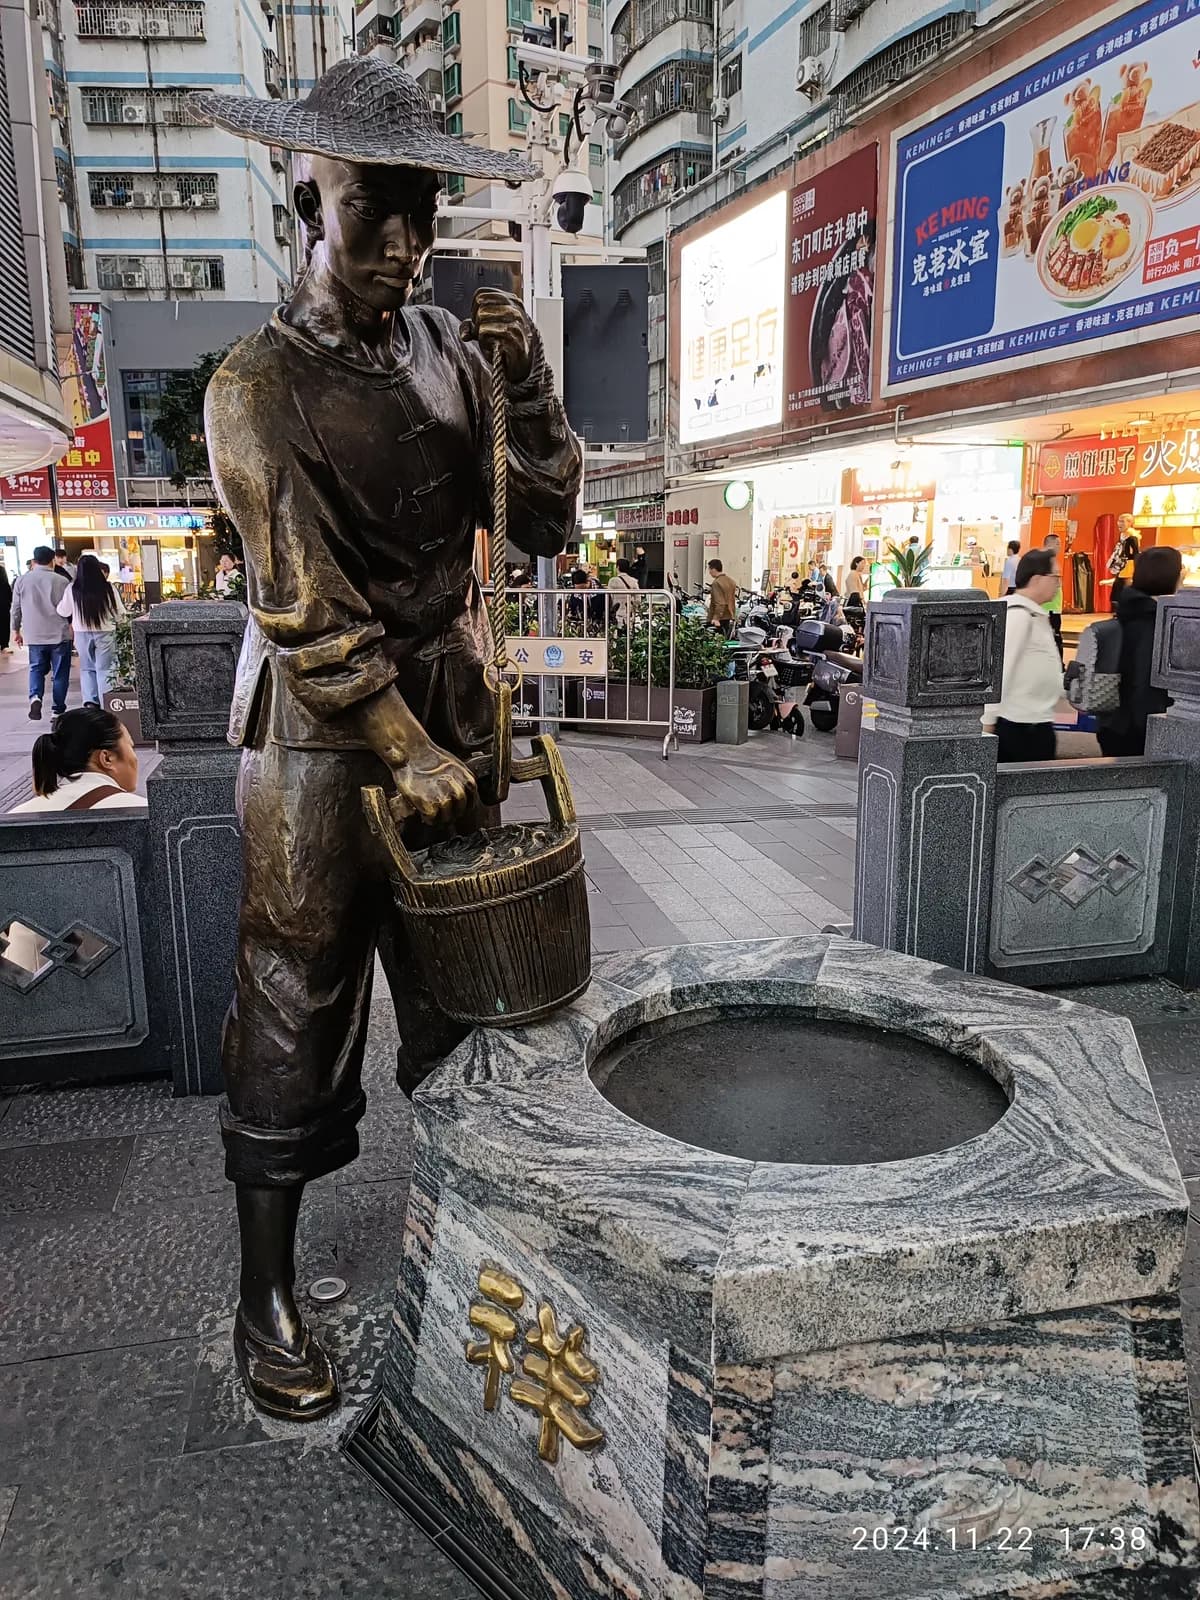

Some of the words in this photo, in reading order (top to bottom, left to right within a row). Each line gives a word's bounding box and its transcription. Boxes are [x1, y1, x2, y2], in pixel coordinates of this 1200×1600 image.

[1024, 61, 1074, 98] KEMING
[906, 132, 943, 160] KEMING
[915, 196, 990, 246] KEMING
[791, 206, 868, 265] 东门町店升级中
[1165, 234, 1200, 260] 负一
[911, 228, 990, 286] 克茗冰室
[688, 306, 778, 381] 健康足疗
[1009, 326, 1057, 348] KEMING
[896, 356, 932, 376] KEMING
[72, 436, 85, 448] 街
[56, 449, 101, 467] 造中
[1063, 445, 1136, 479] 煎饼果子
[107, 515, 147, 528] BXCW
[514, 647, 529, 664] 公
[579, 648, 594, 665] 安
